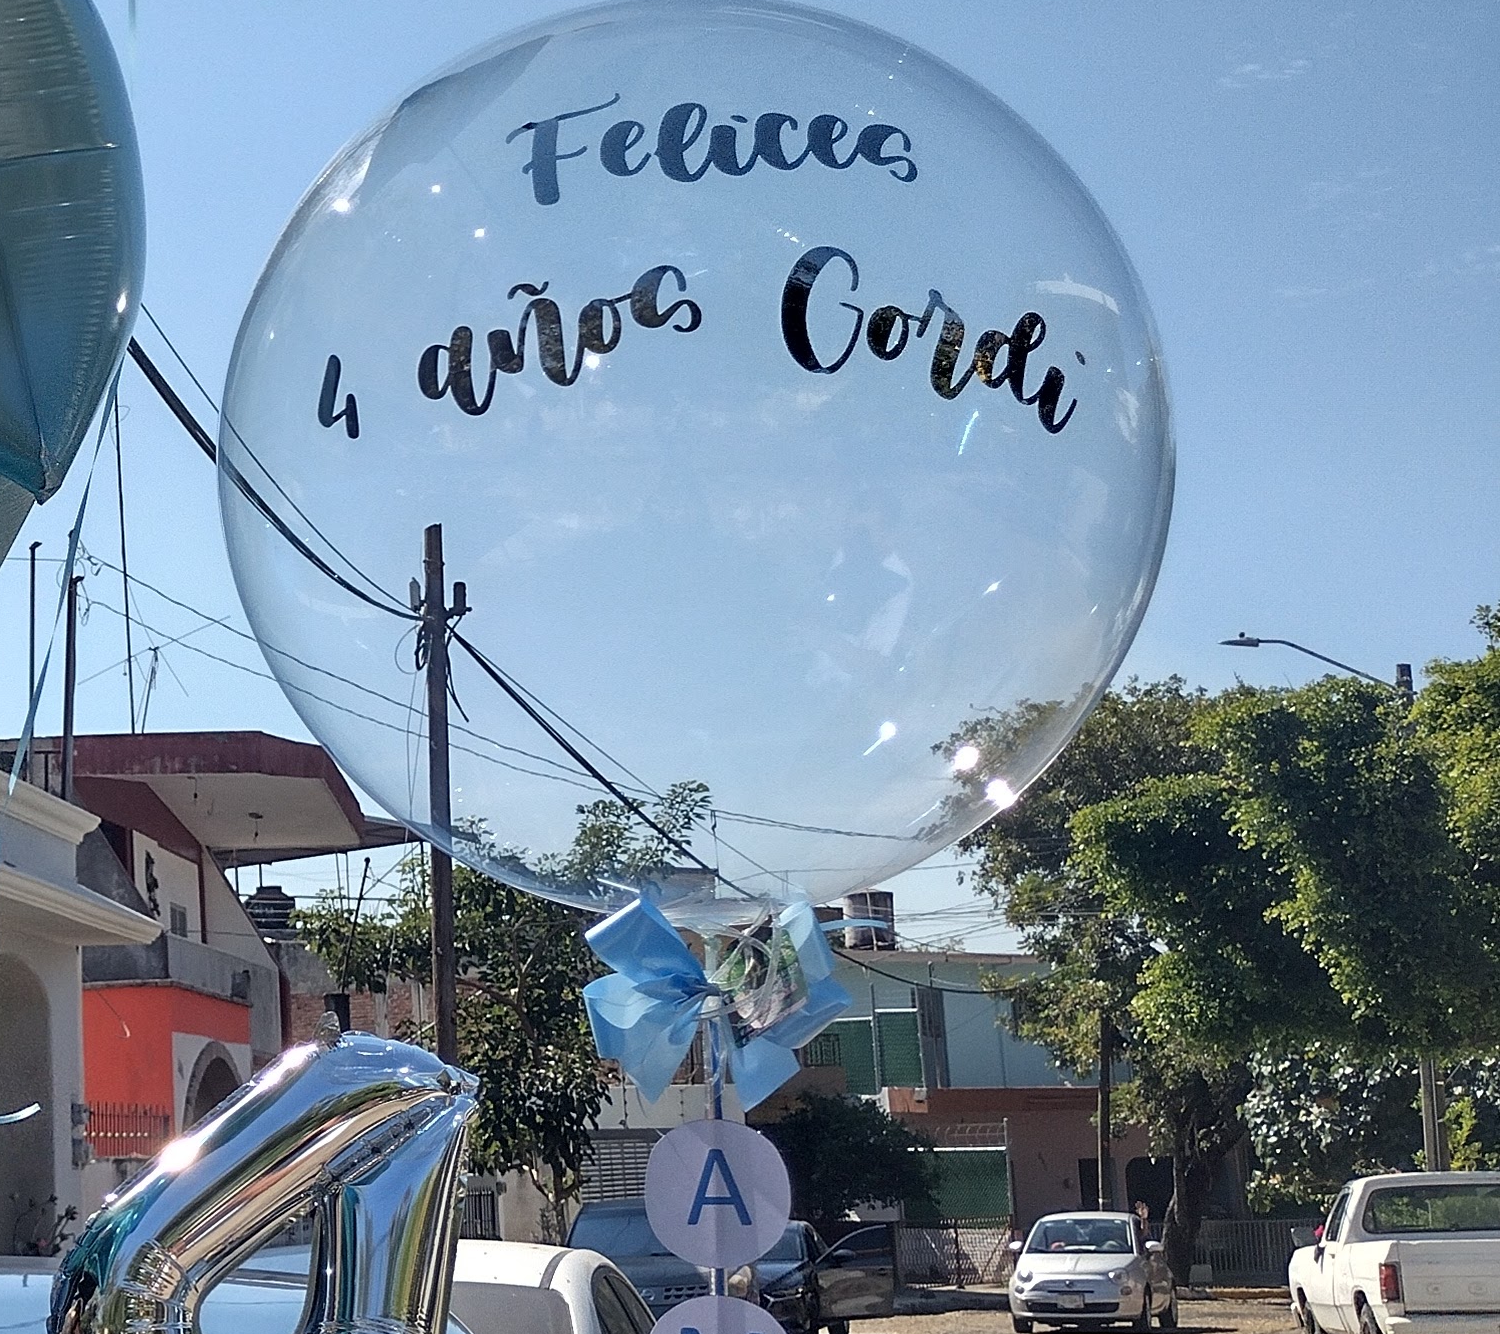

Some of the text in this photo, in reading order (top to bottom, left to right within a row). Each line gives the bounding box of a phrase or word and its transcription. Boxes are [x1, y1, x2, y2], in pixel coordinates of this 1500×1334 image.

[506, 92, 918, 206] Felices
[316, 245, 1087, 439] 4 años Gordi
